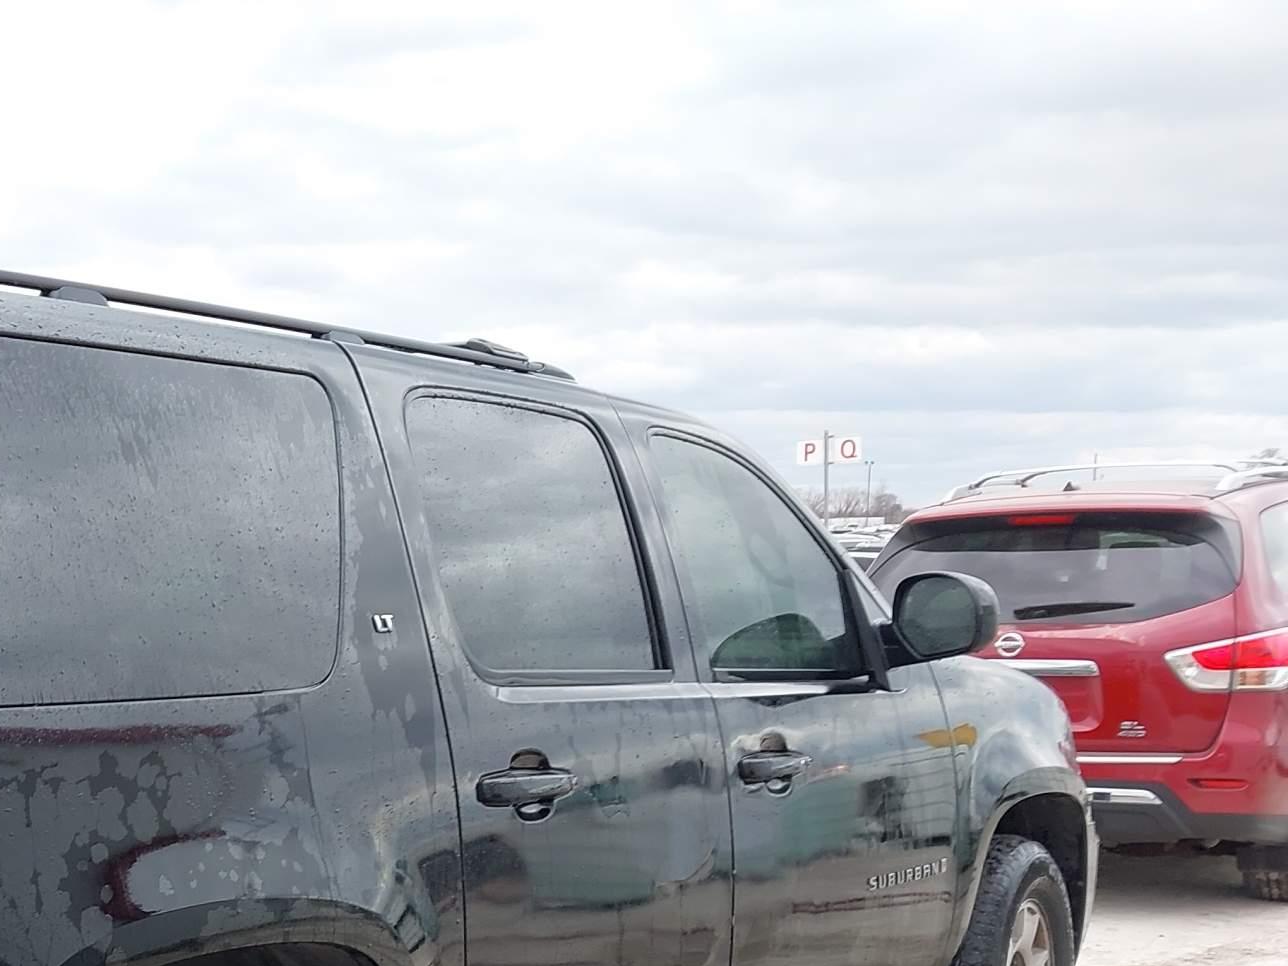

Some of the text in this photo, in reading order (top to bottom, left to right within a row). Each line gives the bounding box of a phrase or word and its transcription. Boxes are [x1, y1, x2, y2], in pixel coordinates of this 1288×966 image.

[804, 442, 816, 462] P
[840, 439, 858, 459] Q
[372, 613, 394, 633] LT
[868, 861, 941, 892] SUBURBAN
